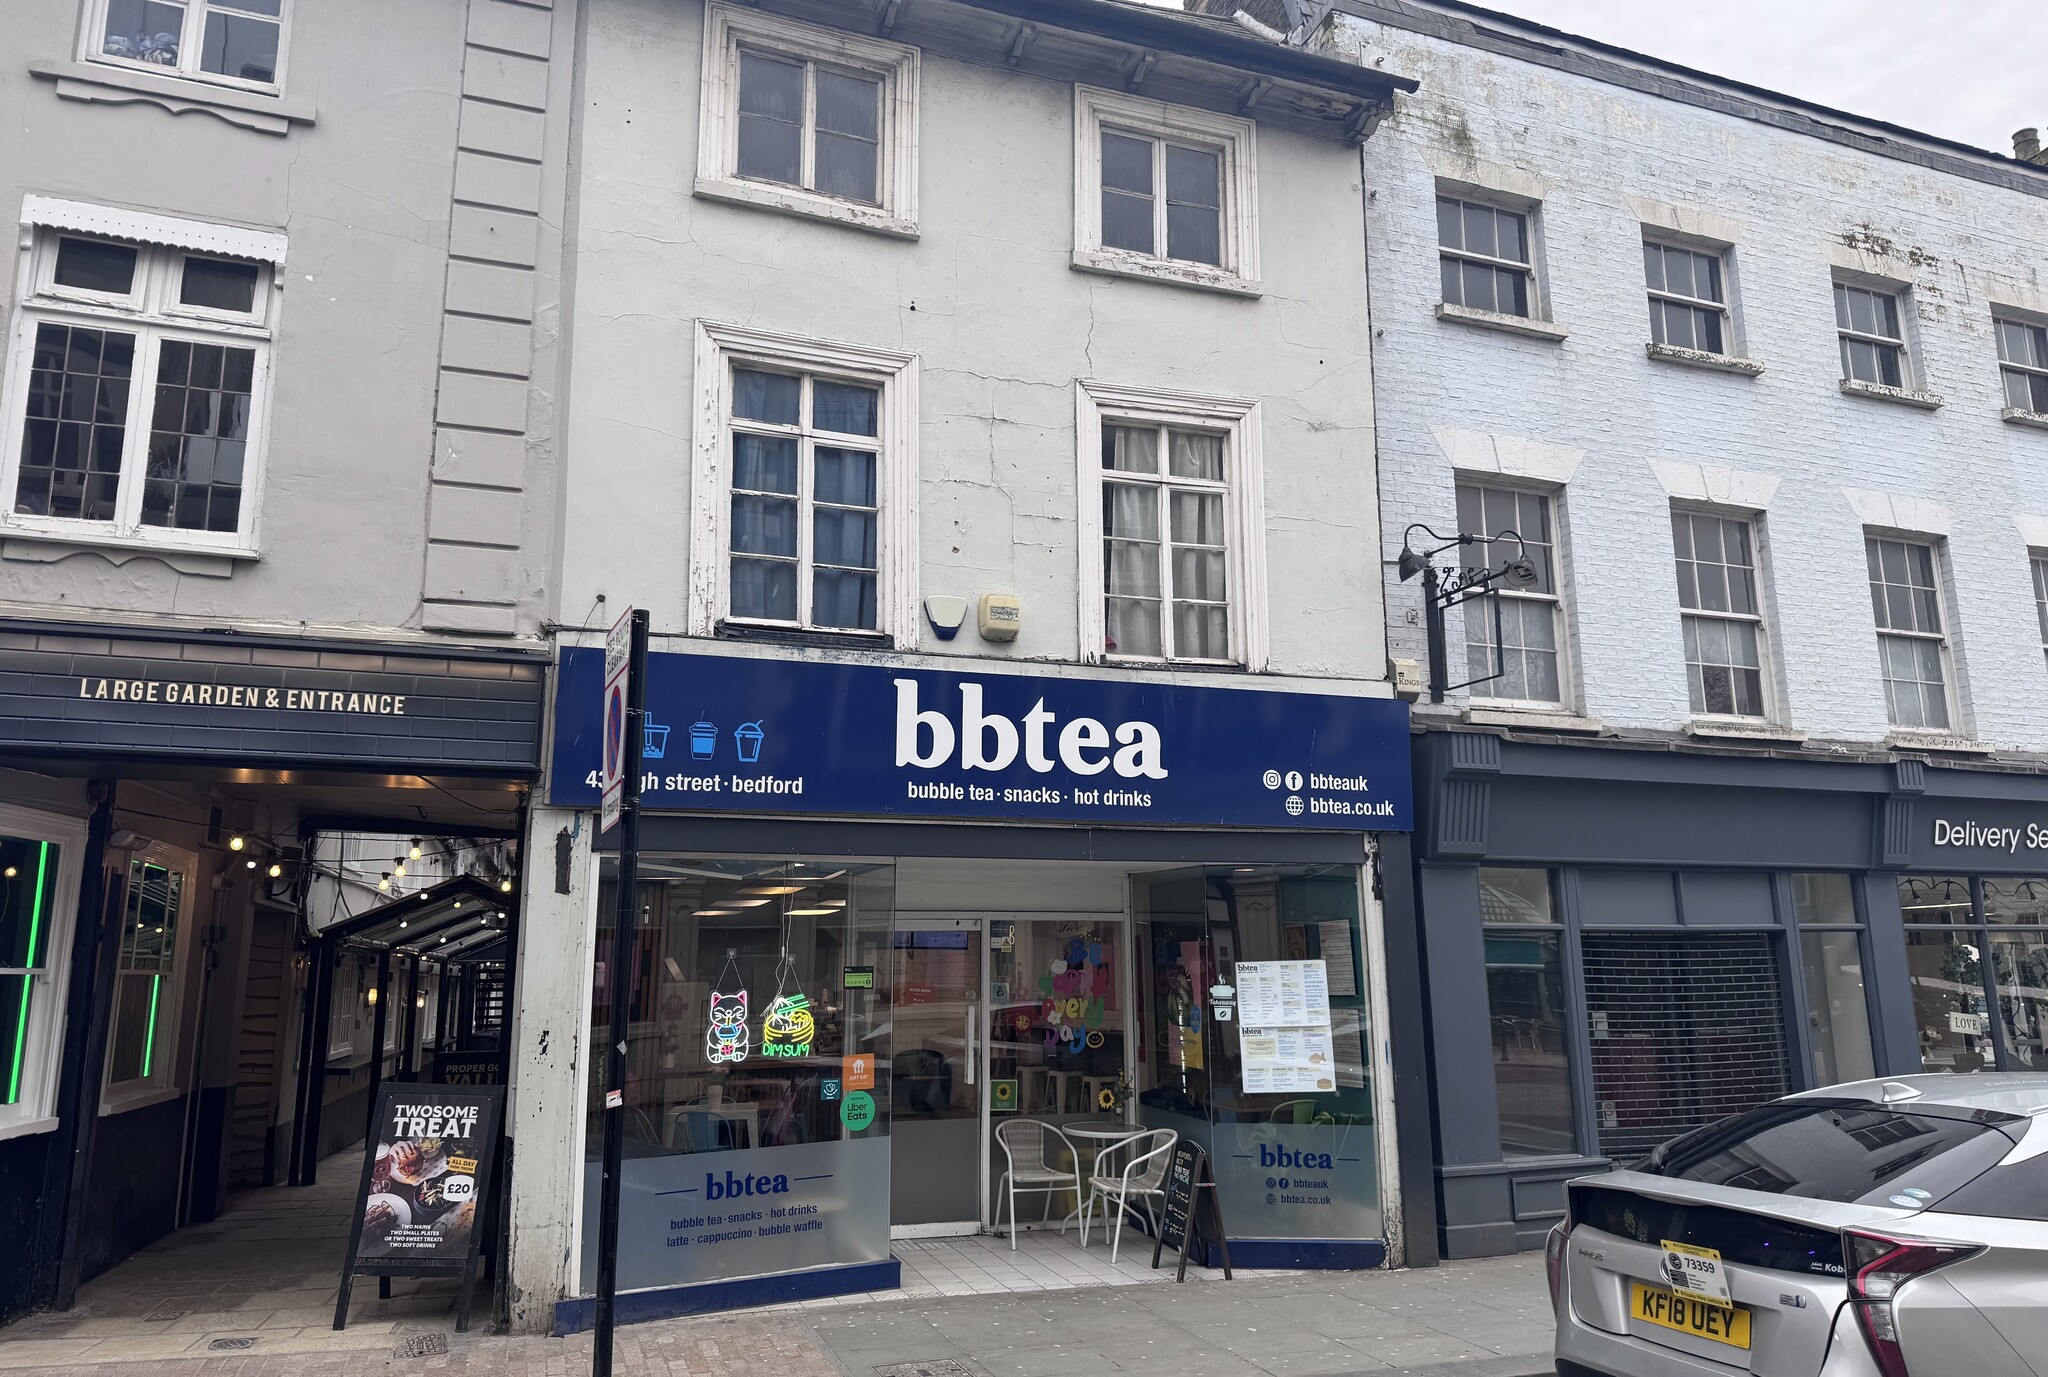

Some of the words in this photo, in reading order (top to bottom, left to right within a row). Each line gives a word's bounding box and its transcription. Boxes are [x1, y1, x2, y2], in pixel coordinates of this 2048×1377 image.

[1398, 678, 1420, 686] KINGS
[80, 678, 160, 702] LARGE
[165, 683, 259, 708] GARDEN
[264, 688, 280, 709] &
[286, 689, 406, 715] ENTRANCE
[893, 678, 1169, 780] bbtea
[665, 773, 721, 792] street
[732, 775, 803, 794] bedford
[1310, 773, 1368, 792] bbteauk
[908, 781, 964, 801] bubble
[969, 784, 994, 801] tea
[1004, 786, 1061, 804] snacks
[1074, 788, 1099, 805] hot
[1103, 789, 1152, 807] drinks
[1310, 797, 1394, 816] bbtea.co.uk
[1934, 819, 2020, 854] Delivery
[1238, 964, 1258, 972] bbtea
[1955, 1017, 1978, 1030] LOVE
[446, 1064, 486, 1073] PROPER
[394, 1104, 479, 1118] TWOSOME
[848, 1103, 868, 1112] Uber
[848, 1112, 868, 1120] Eats
[392, 1117, 477, 1138] TREAT
[1260, 1144, 1334, 1170] bbtea
[447, 1184, 470, 1194] £20
[706, 1171, 790, 1200] bbtea
[1293, 1178, 1329, 1188] bbteauk
[1281, 1194, 1332, 1204] bbtea.co.uk
[670, 1216, 704, 1230] bubble
[707, 1215, 722, 1226] tea
[728, 1210, 762, 1224] snacks
[770, 1206, 786, 1218] hot
[788, 1204, 818, 1216] drinks
[666, 1236, 689, 1248] latte
[697, 1228, 753, 1246] cappuccino
[758, 1224, 791, 1236] bubble
[794, 1220, 823, 1232] waffle
[1684, 1257, 1715, 1274] 73359
[1824, 1264, 1846, 1273] Kob
[1642, 1290, 1686, 1326] KF18
[1692, 1302, 1734, 1338] UEY
